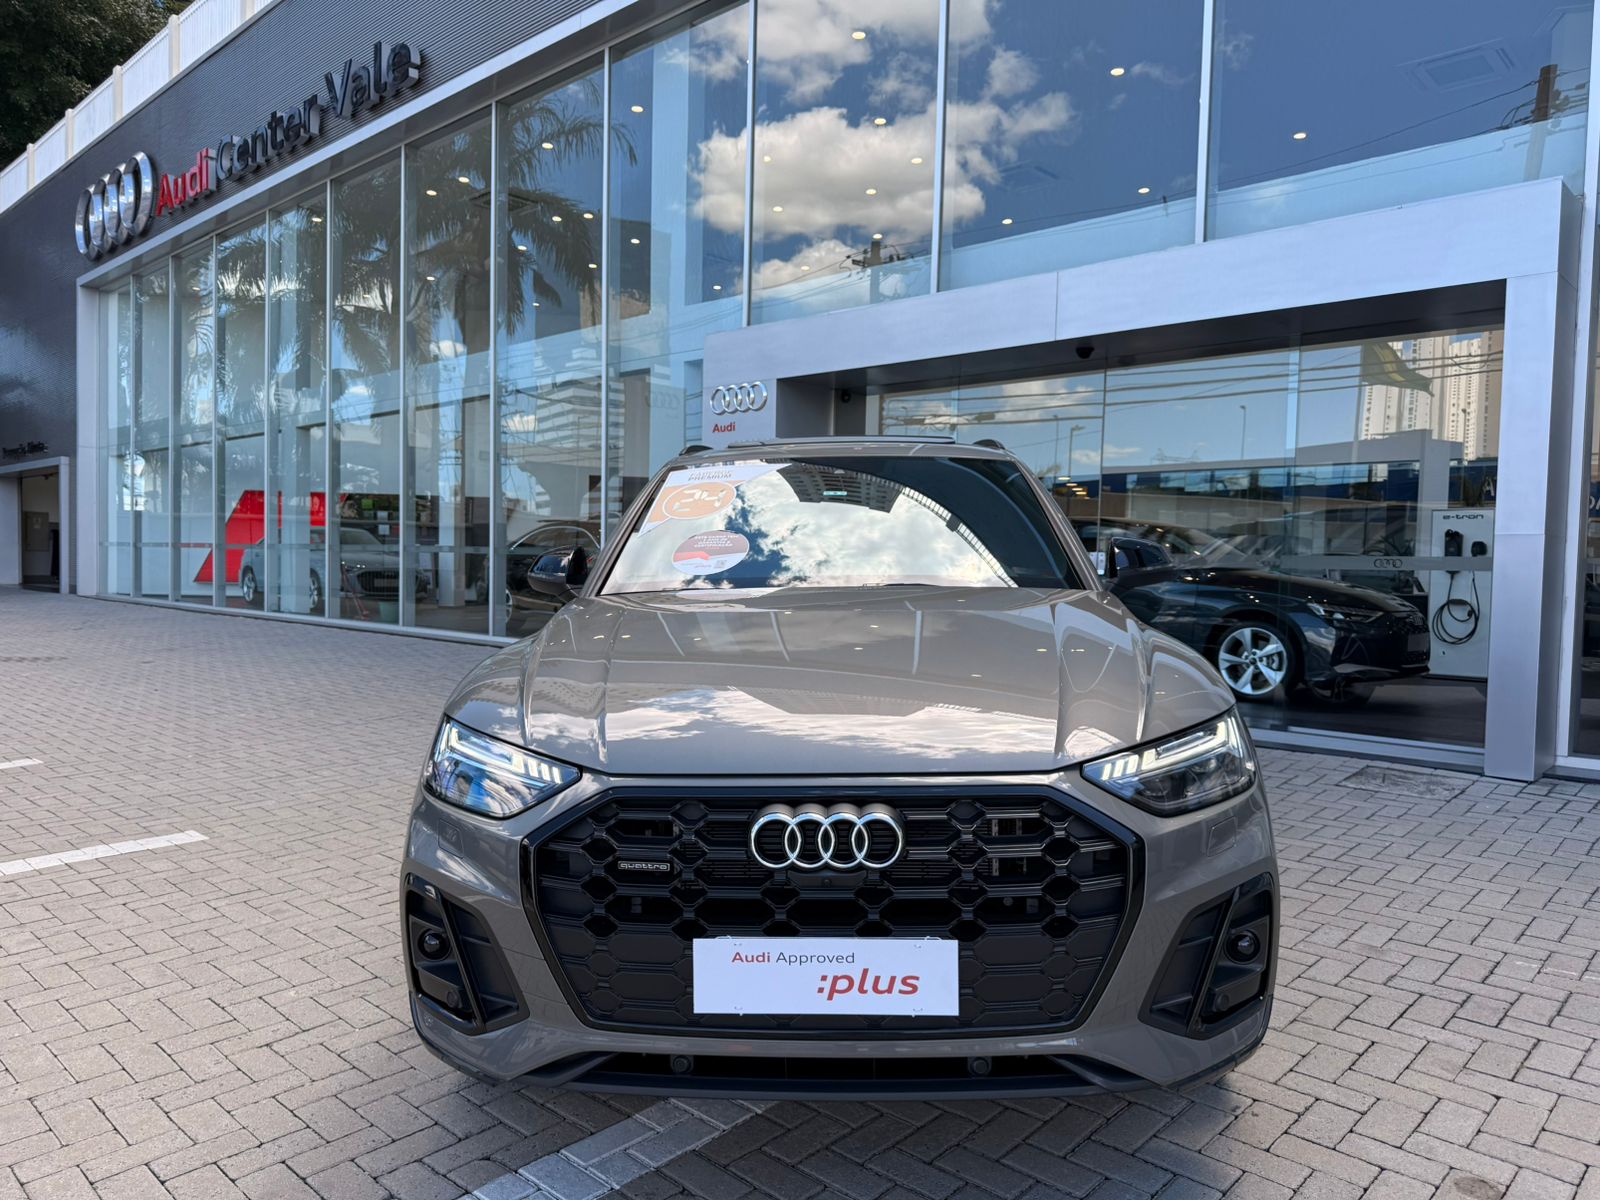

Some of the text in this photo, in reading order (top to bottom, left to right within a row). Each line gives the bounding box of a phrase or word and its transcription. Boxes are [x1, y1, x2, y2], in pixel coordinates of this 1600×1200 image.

[155, 40, 422, 217] Audi Center Vale
[712, 421, 736, 433] Audi
[731, 951, 855, 966] Audi Approved
[817, 968, 920, 1001] :plus
